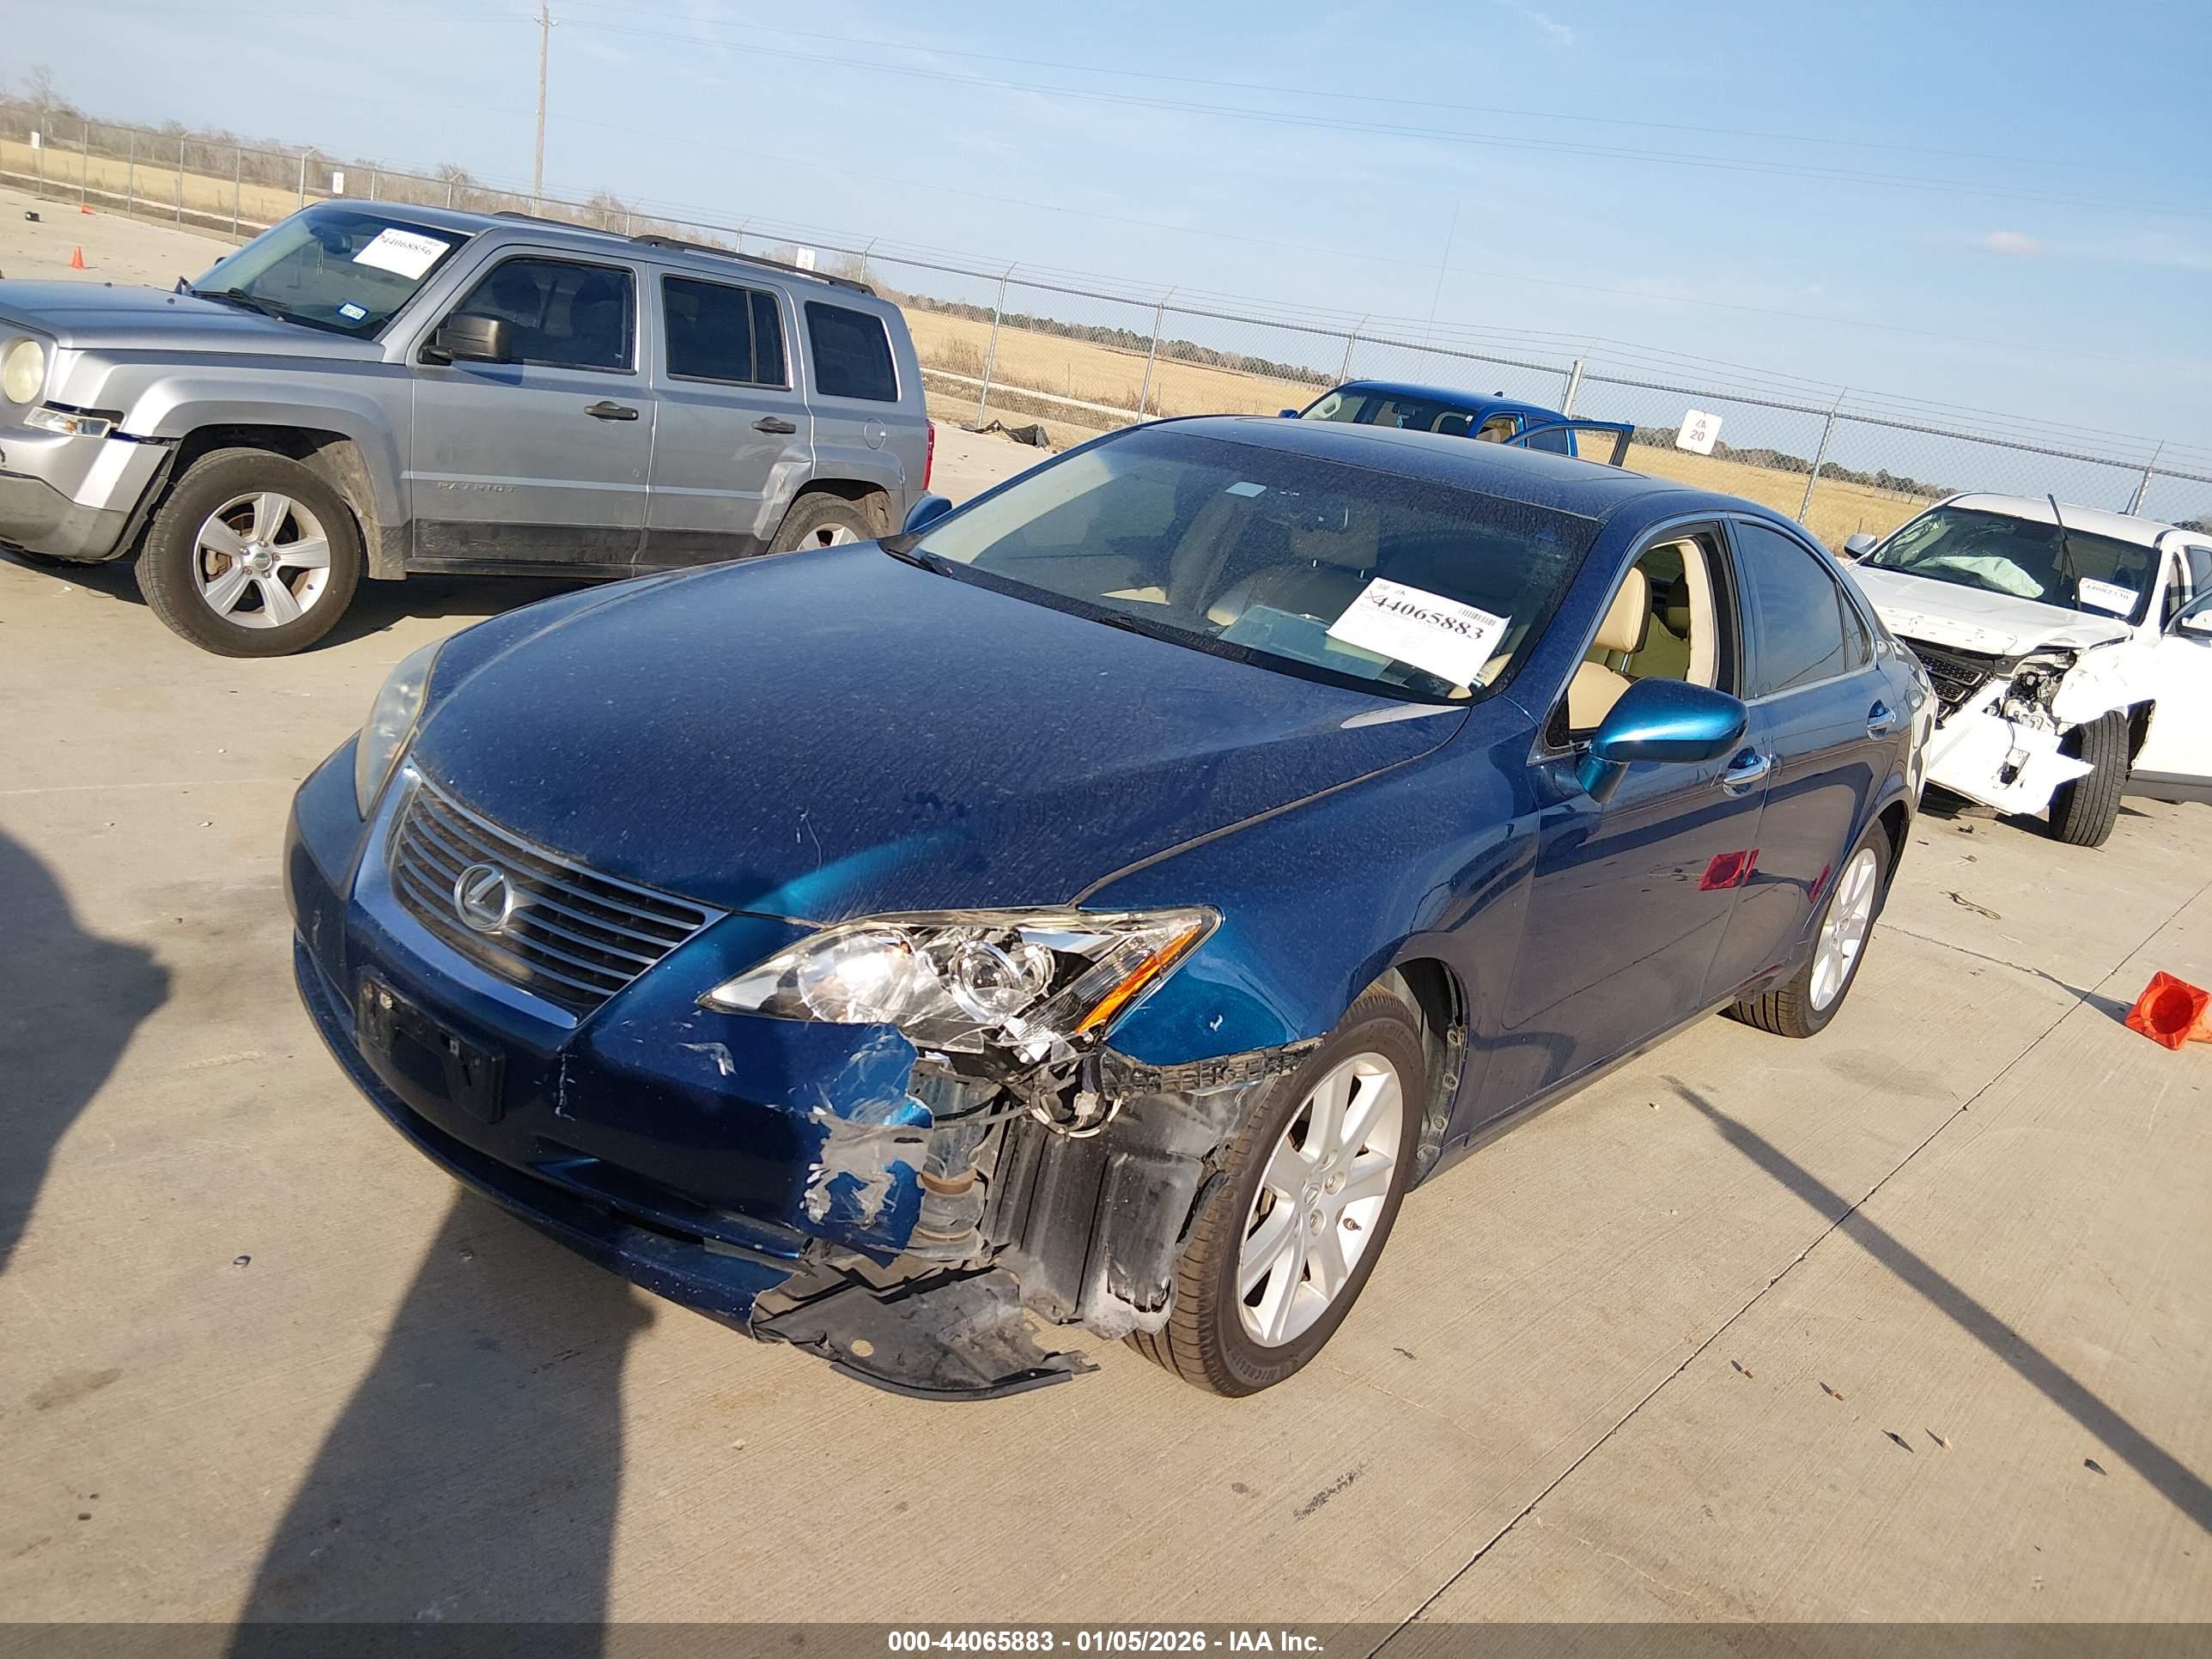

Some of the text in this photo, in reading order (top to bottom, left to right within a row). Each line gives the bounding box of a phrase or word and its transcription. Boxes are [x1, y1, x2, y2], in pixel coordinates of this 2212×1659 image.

[1689, 429, 1705, 441] 20
[438, 481, 518, 494] PATRIOT
[1373, 596, 1485, 641] 44065883
